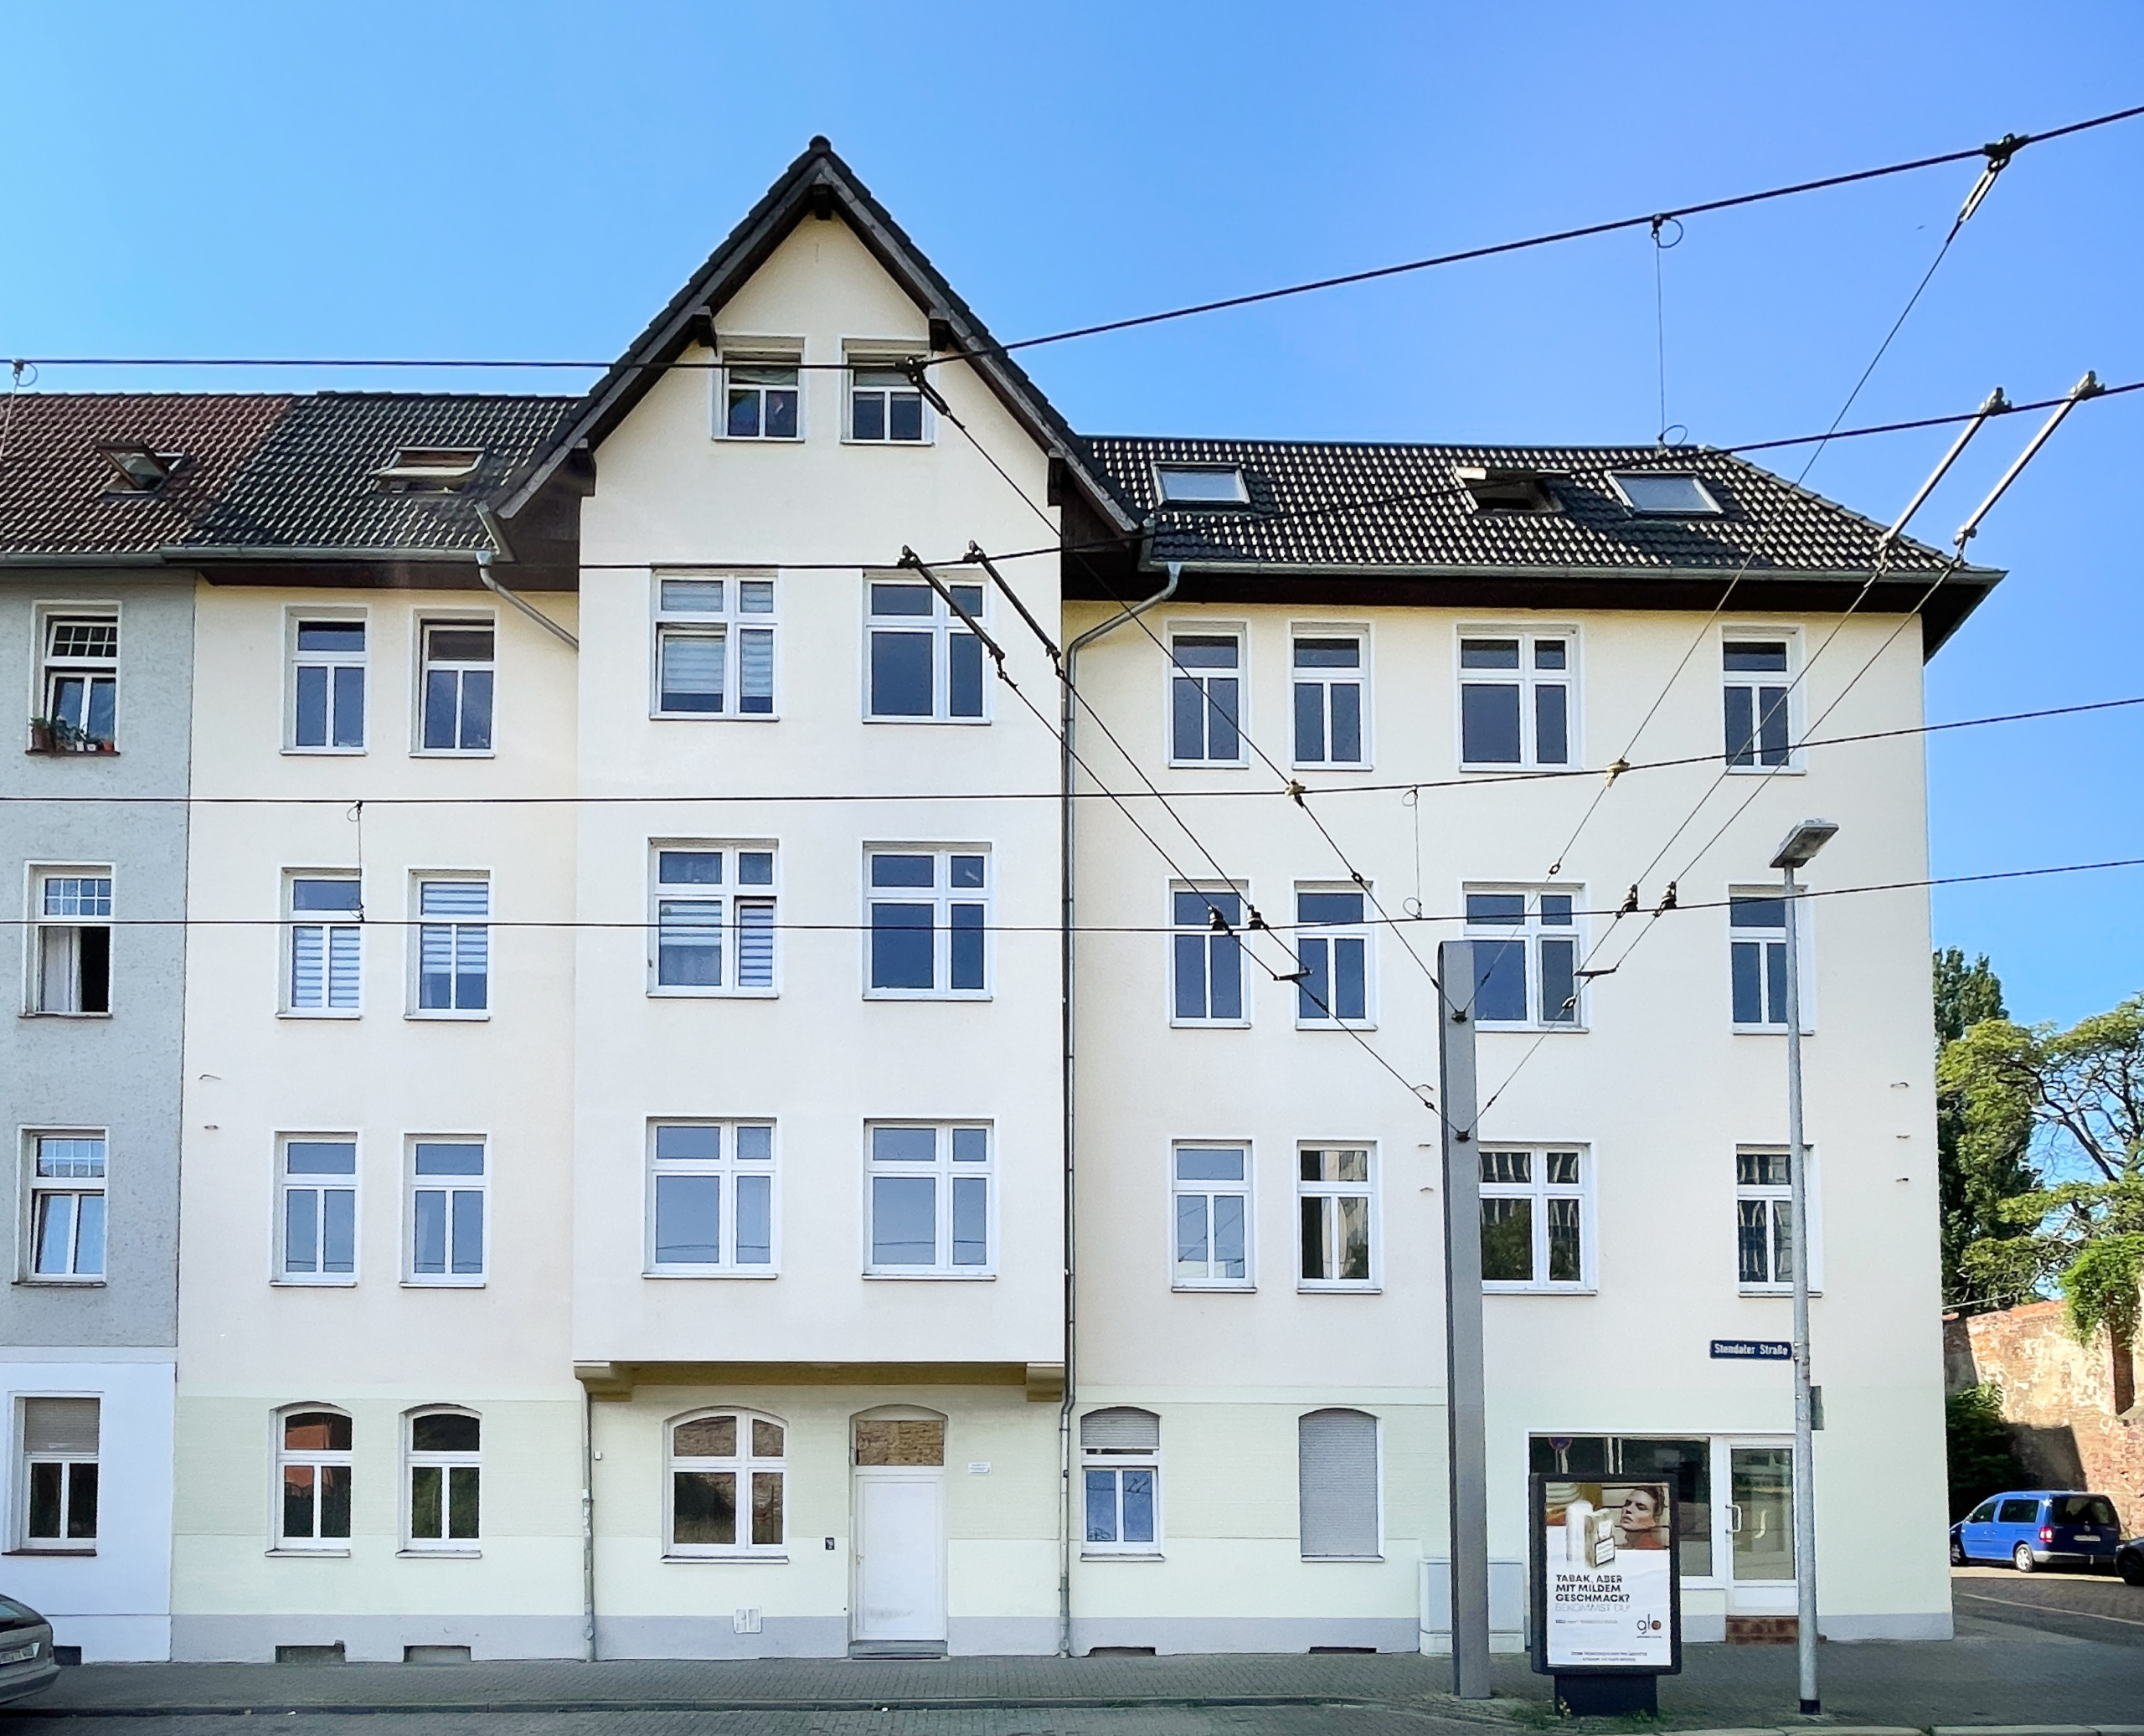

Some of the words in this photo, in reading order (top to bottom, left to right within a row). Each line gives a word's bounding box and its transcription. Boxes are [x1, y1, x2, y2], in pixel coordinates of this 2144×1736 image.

[1714, 1343, 1755, 1354] Stendaler
[1760, 1344, 1788, 1356] Straße
[1556, 1574, 1594, 1584] TABAK,
[1555, 1594, 1631, 1602] GESCHMACK?
[1555, 1604, 1611, 1612] BEKOMMST
[1636, 1613, 1662, 1634] glo
